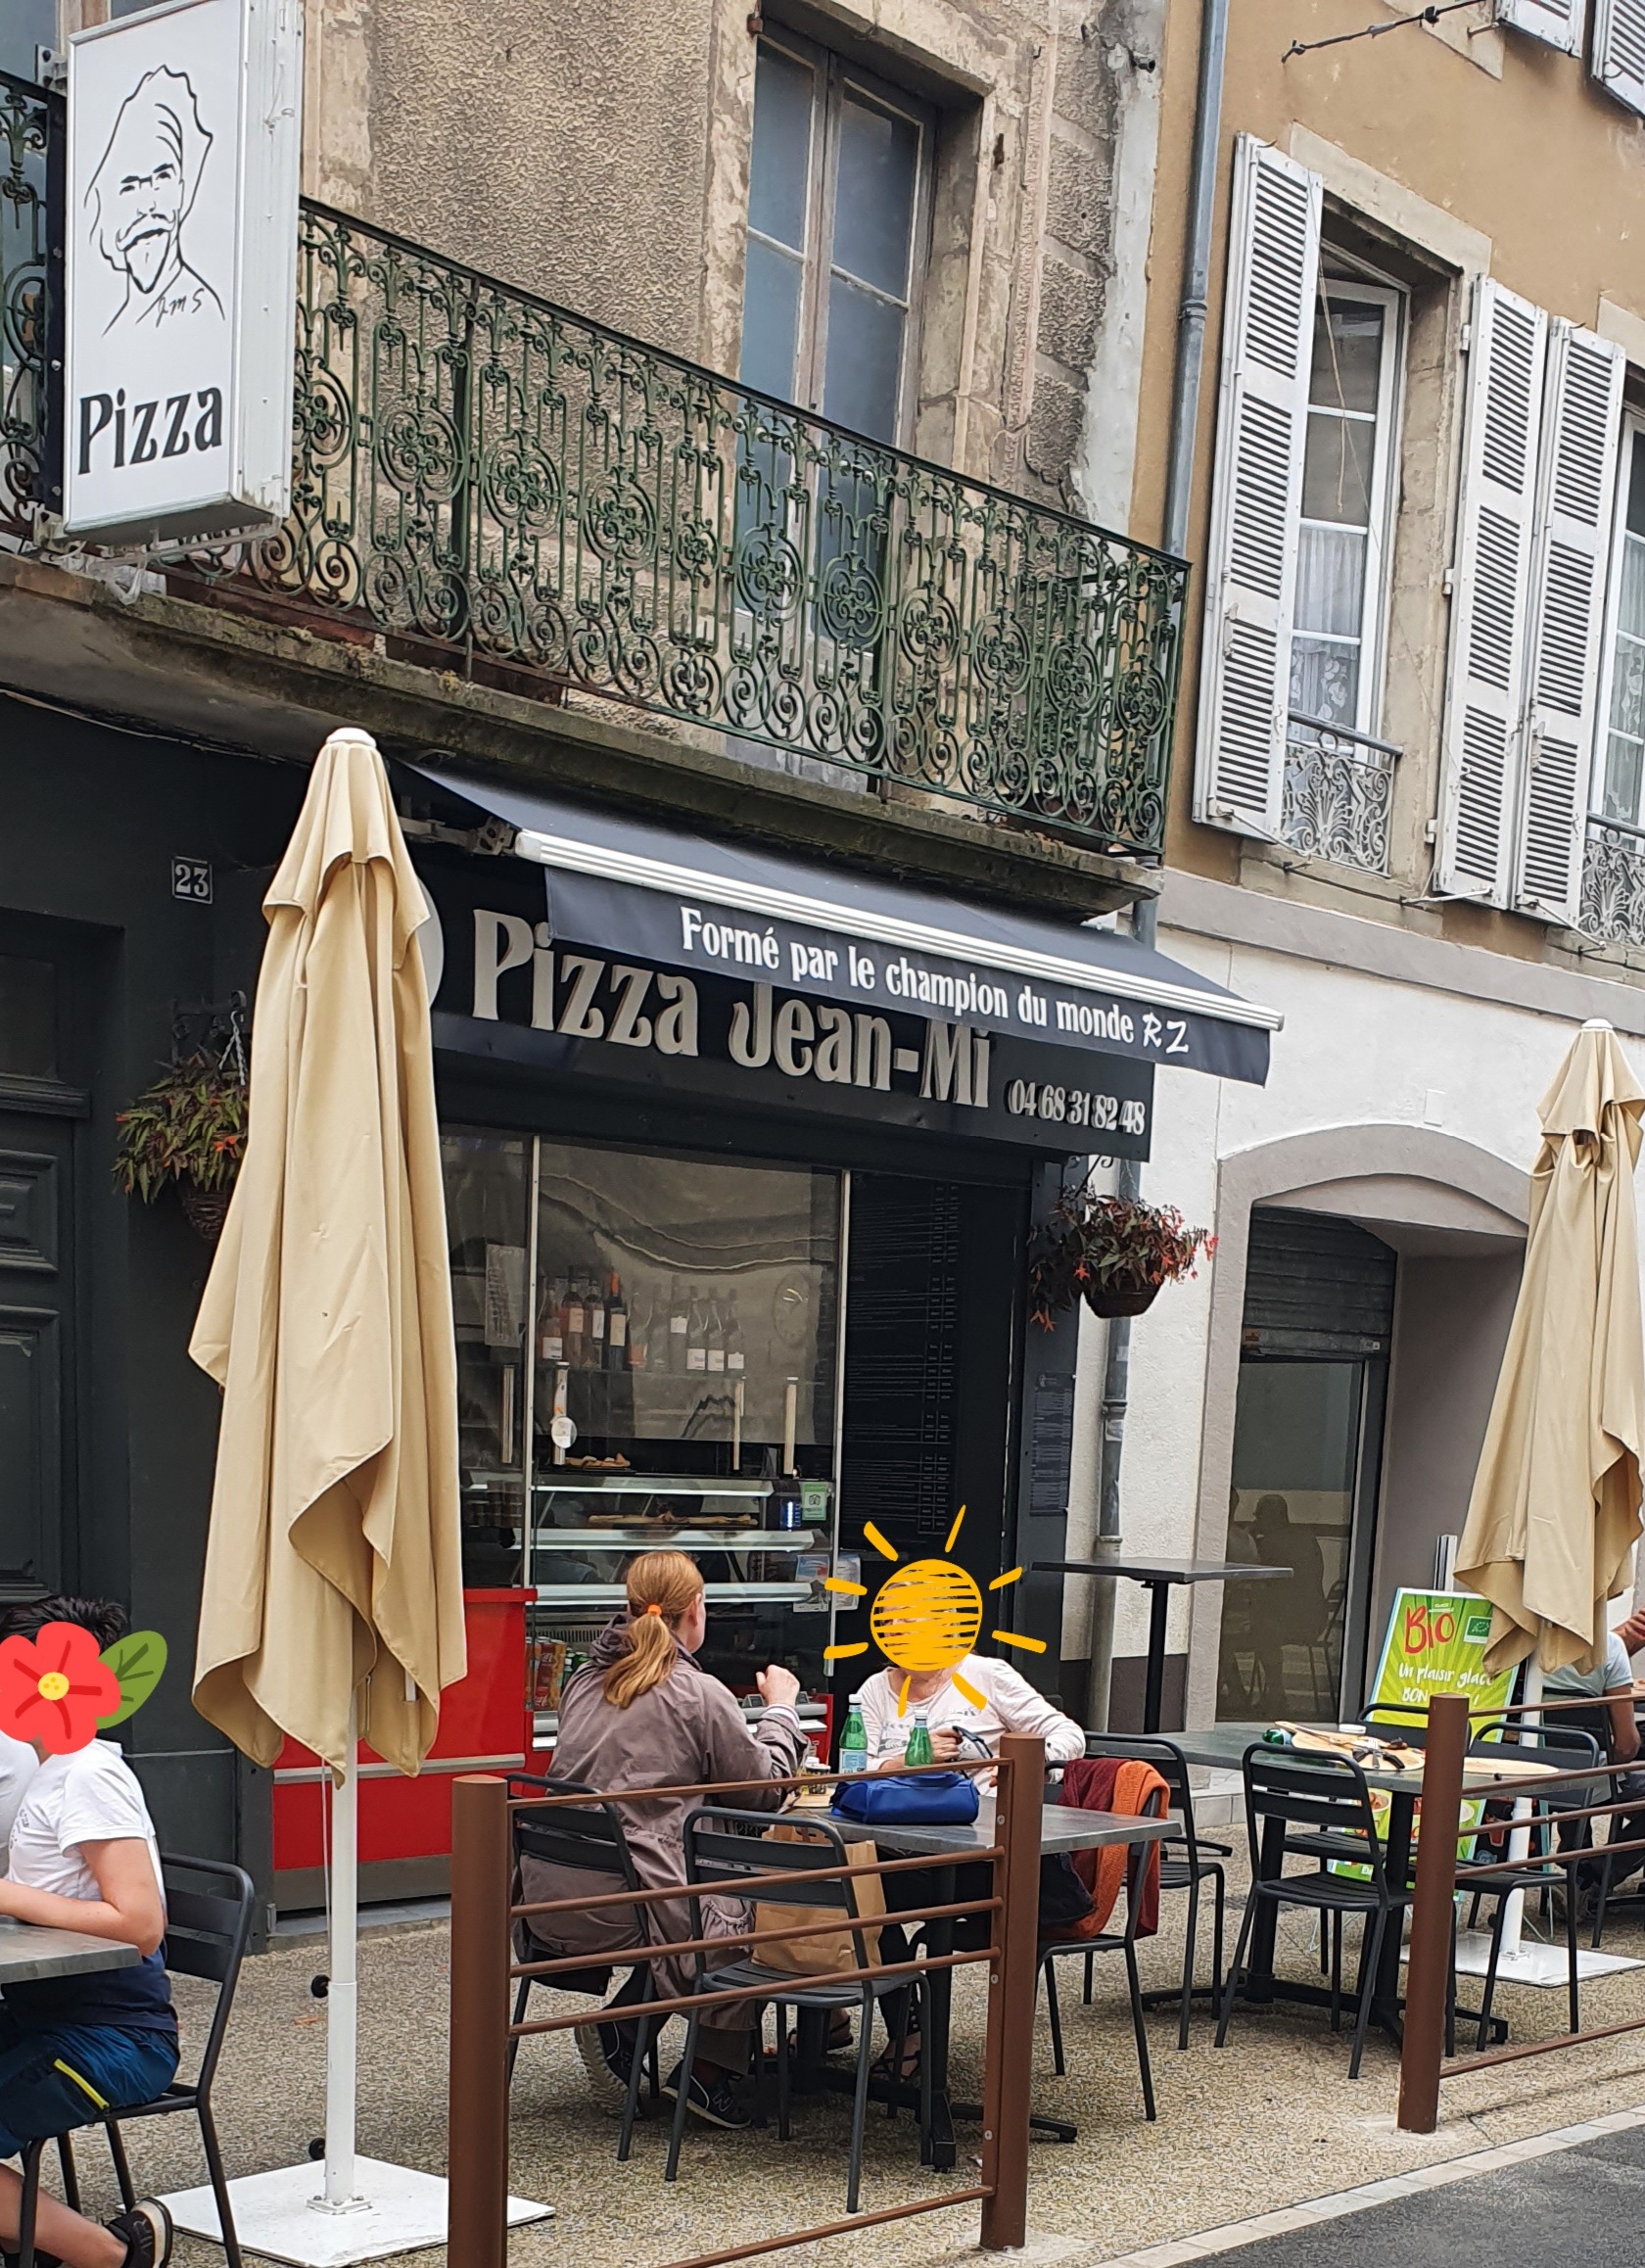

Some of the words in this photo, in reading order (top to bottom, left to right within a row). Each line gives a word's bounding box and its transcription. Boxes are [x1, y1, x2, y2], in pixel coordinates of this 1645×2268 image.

[78, 387, 222, 475] Pizza
[175, 864, 209, 897] 23
[472, 909, 699, 1057] Pizza
[728, 981, 990, 1108] Jean-Mi
[680, 906, 779, 969] Formé
[789, 941, 839, 982] par
[848, 945, 875, 990] le
[885, 957, 1010, 1018] champion
[1017, 985, 1048, 1026] du
[1056, 1003, 1135, 1044] monde
[1398, 1663, 1413, 1678] Un
[1416, 1663, 1455, 1684] plaisir
